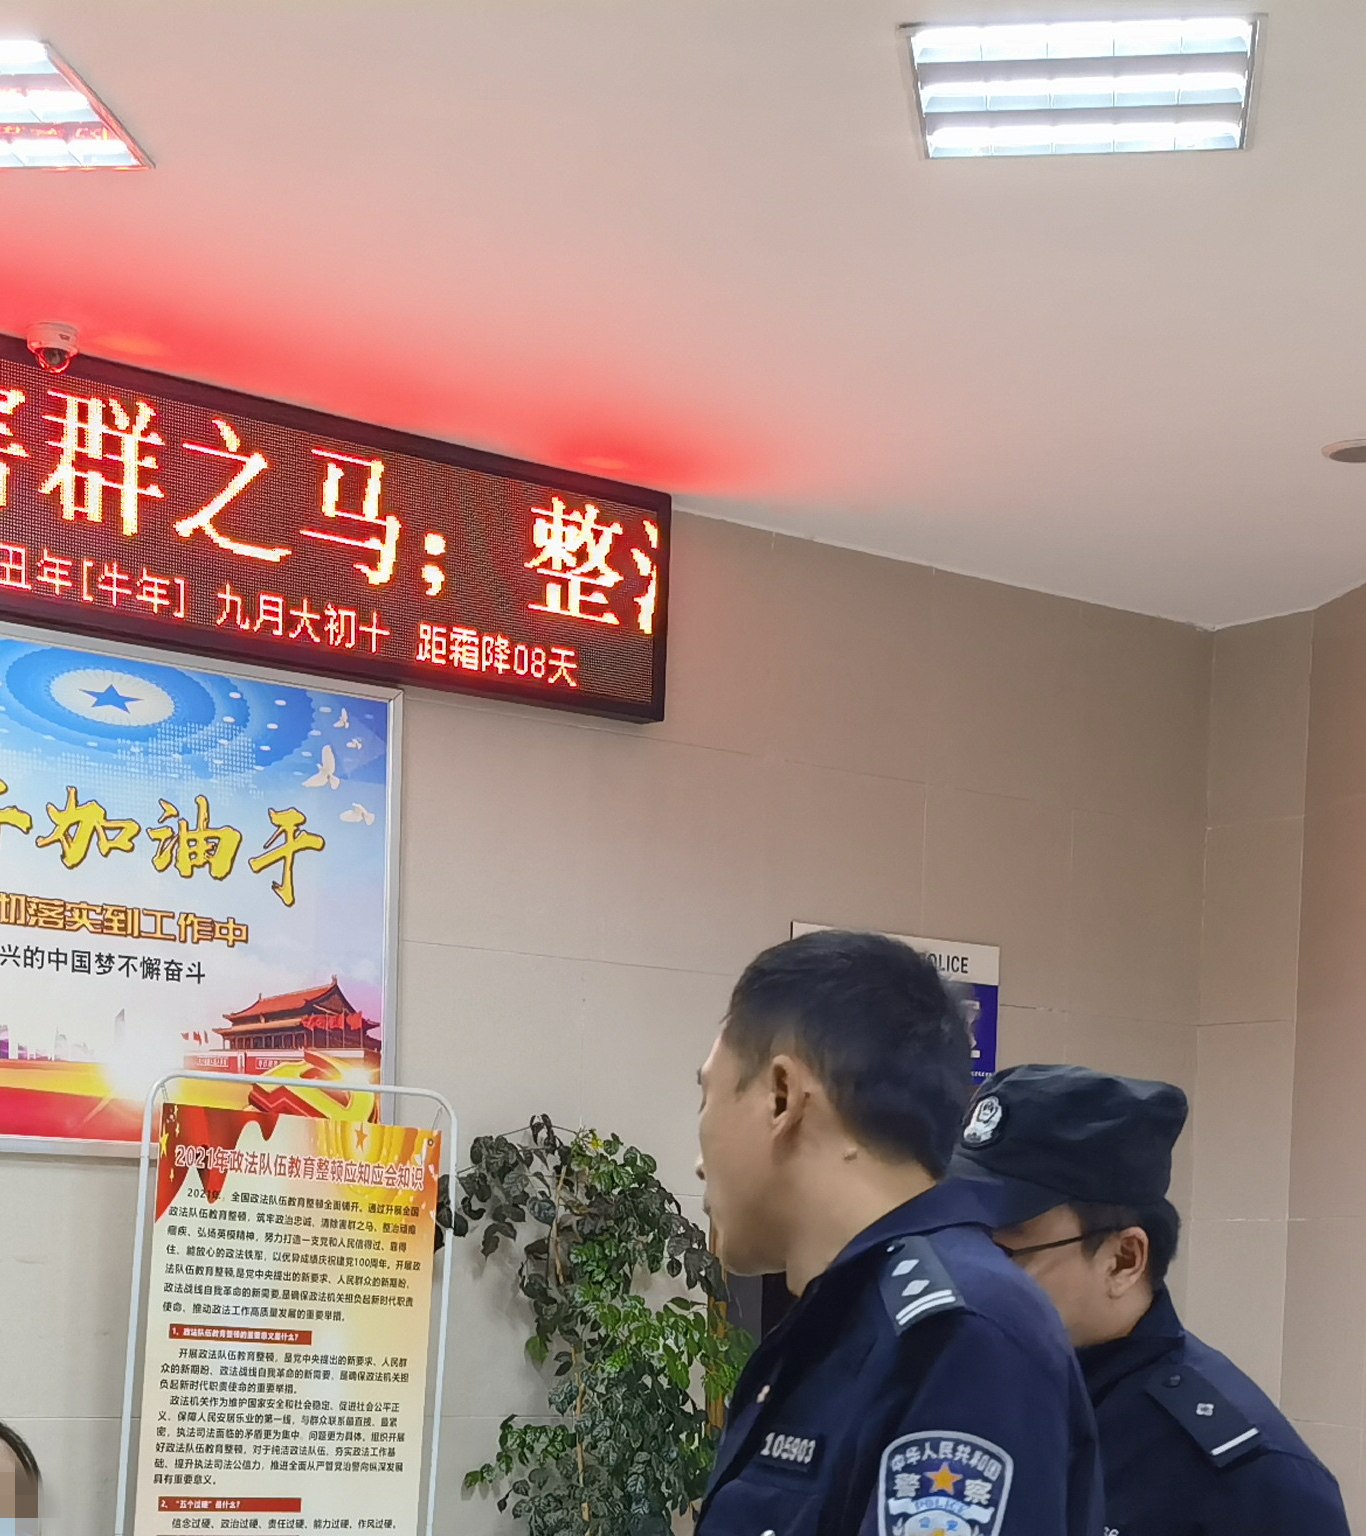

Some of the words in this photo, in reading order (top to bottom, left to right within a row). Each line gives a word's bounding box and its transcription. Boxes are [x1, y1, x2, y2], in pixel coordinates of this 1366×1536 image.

[215, 583, 391, 653] 九月大初十
[415, 624, 579, 688] 距霜降08天
[920, 954, 969, 974] OLICE
[174, 1145, 424, 1191] 2021年政法队伍教育整顿应知应会知识
[890, 1440, 1003, 1482] 中华人民共和国
